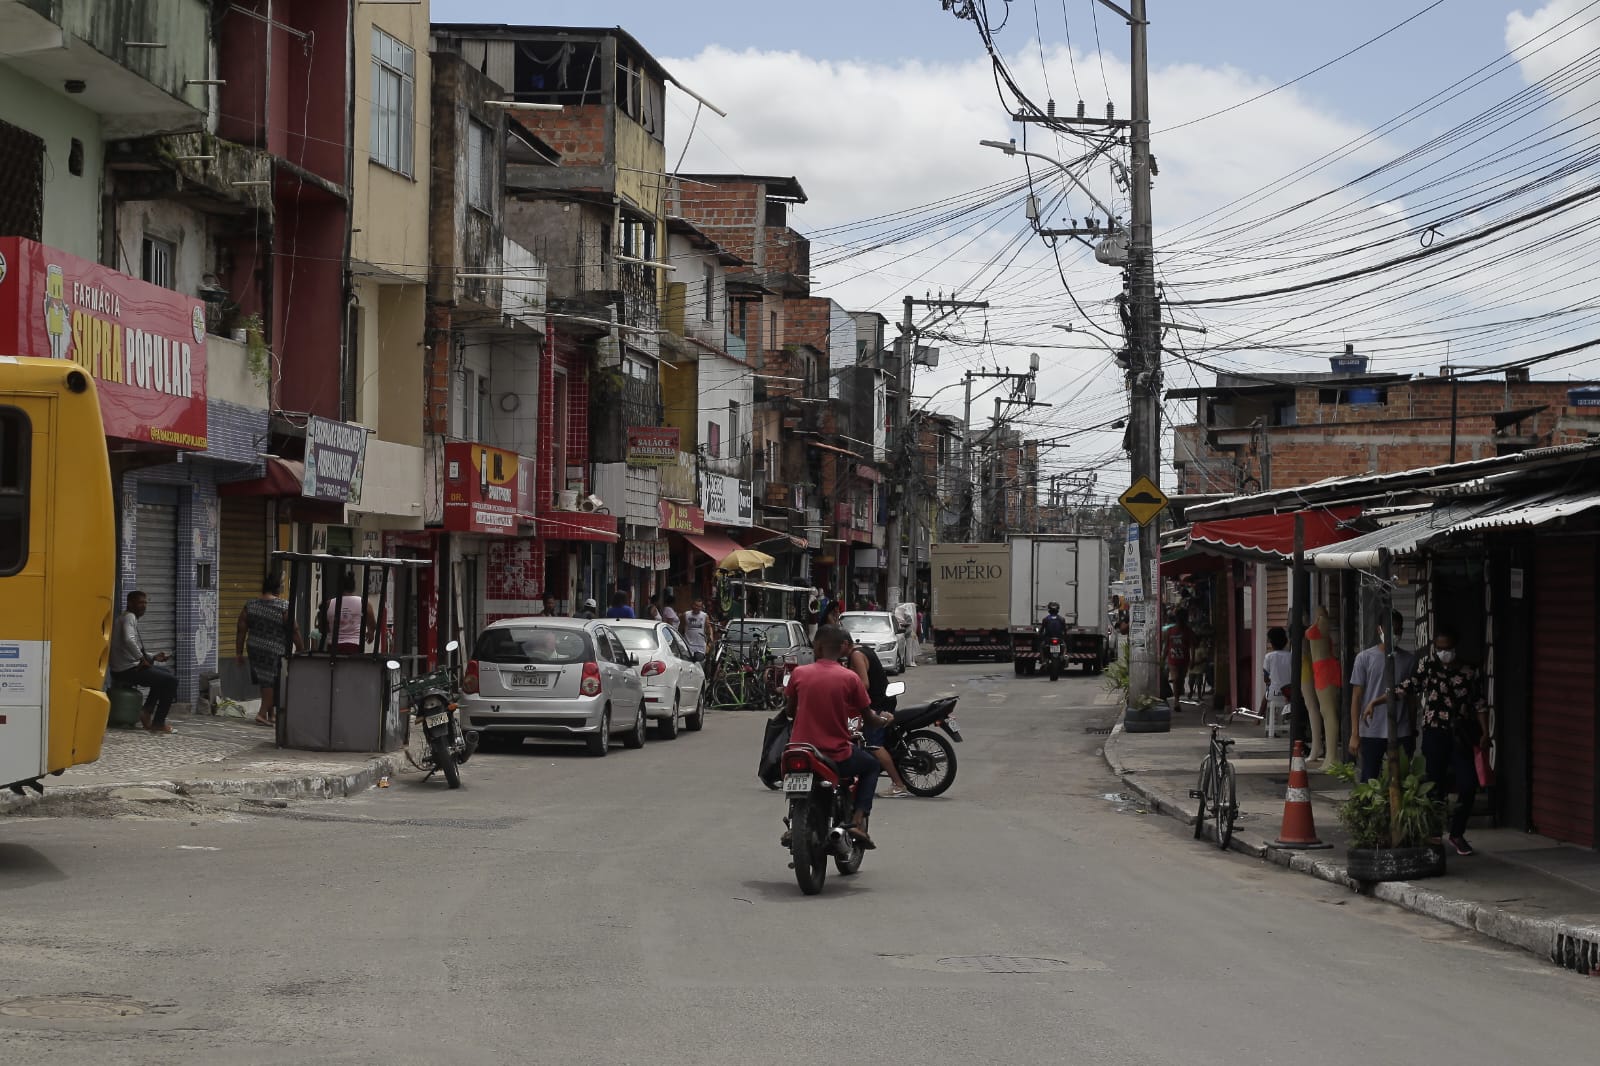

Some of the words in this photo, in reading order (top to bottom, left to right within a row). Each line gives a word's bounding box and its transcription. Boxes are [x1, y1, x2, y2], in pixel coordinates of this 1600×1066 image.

[73, 281, 121, 317] FARMÁCIA
[72, 310, 123, 384] SUPRA
[126, 327, 192, 398] POPULAR
